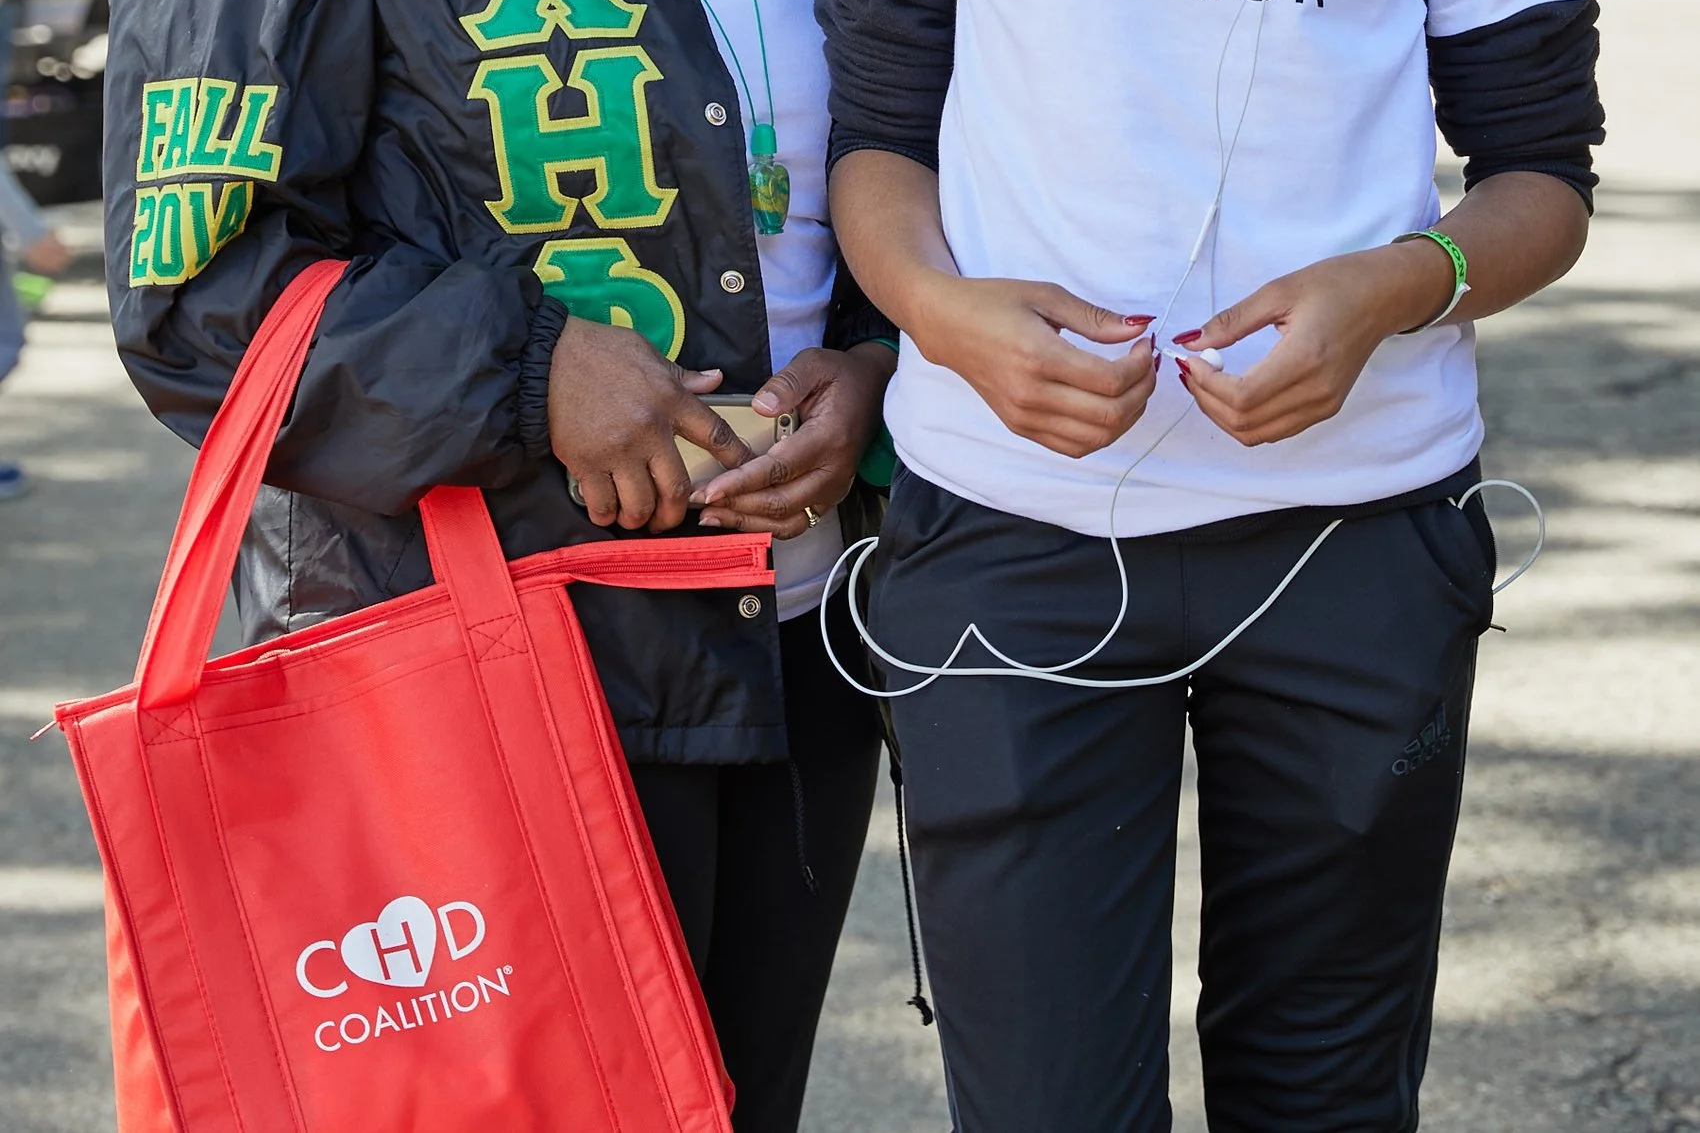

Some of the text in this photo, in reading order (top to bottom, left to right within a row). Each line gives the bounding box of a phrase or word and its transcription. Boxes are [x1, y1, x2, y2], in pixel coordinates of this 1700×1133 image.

[136, 77, 283, 182] FALL
[129, 180, 255, 288] 2014
[296, 901, 486, 998] CHD
